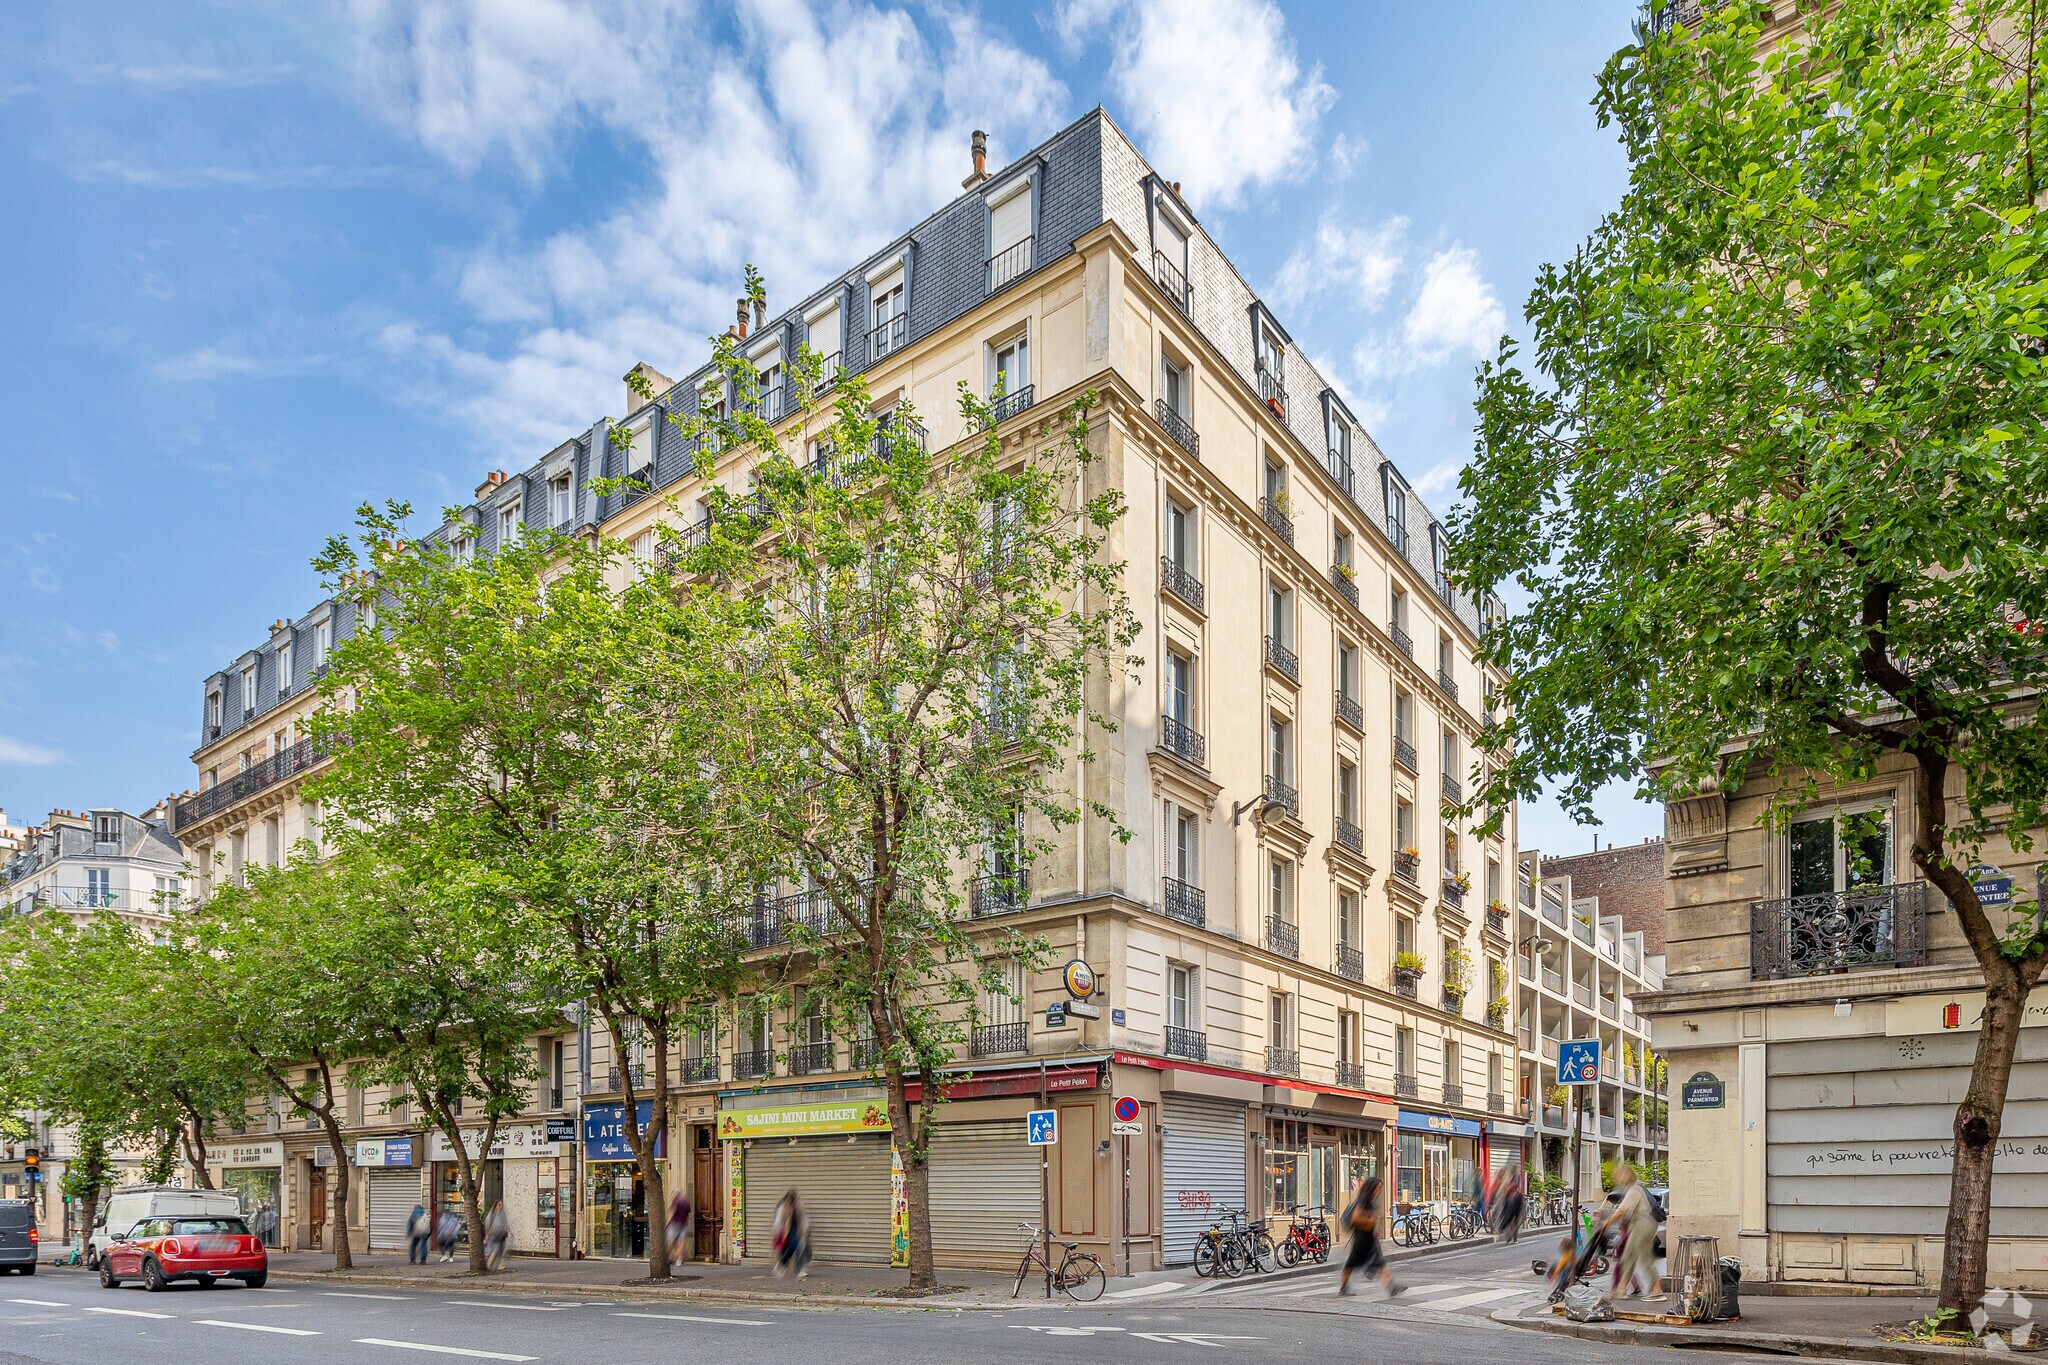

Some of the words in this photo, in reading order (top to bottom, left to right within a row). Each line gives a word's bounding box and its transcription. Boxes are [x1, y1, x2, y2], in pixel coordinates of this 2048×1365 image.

[1974, 884, 1998, 893] ENUE
[1978, 892, 2010, 902] ENTIER
[1121, 1055, 1128, 1063] Le
[1127, 1056, 1137, 1064] Petit
[1050, 1080, 1058, 1088] Le
[1058, 1079, 1072, 1087] Petit
[1071, 1077, 1088, 1085] Pékin
[746, 1113, 780, 1125] SAJINI
[782, 1111, 807, 1124] MINI
[809, 1108, 857, 1122] MARKET
[548, 1126, 575, 1135] COIFFURE
[600, 1122, 650, 1138] ATEE
[361, 1146, 375, 1157] Lyco
[1806, 1149, 1824, 1168] qui
[1872, 1149, 1884, 1162] la
